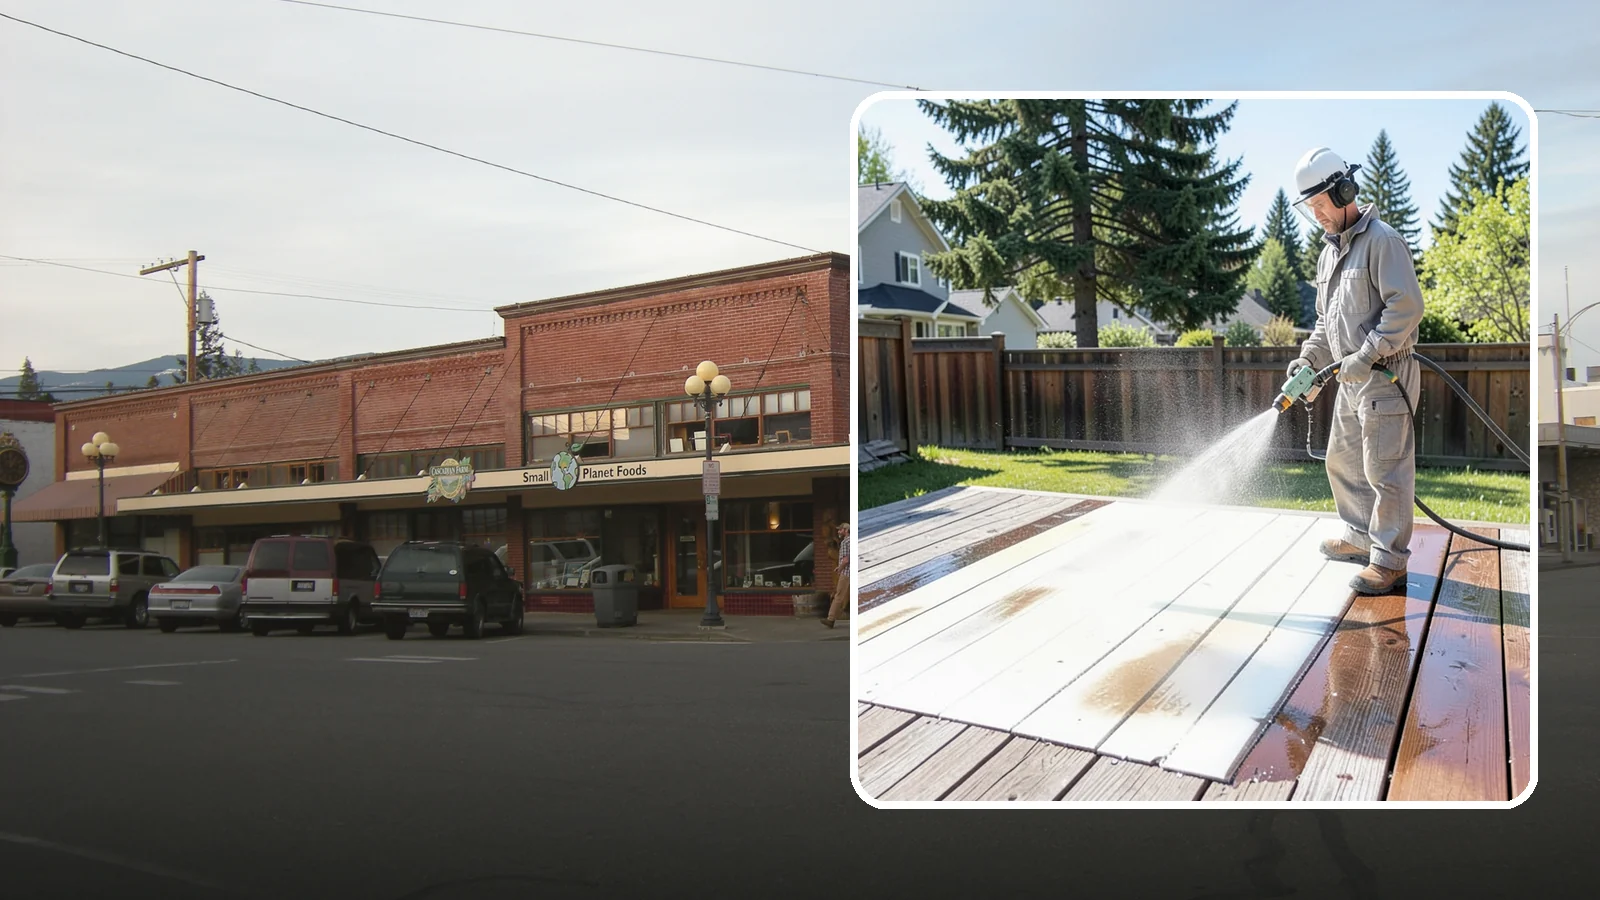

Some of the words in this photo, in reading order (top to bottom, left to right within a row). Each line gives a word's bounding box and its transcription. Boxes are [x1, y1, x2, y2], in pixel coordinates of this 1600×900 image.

[523, 470, 549, 483] Small
[582, 467, 614, 479] Planet
[616, 464, 647, 477] Foods
